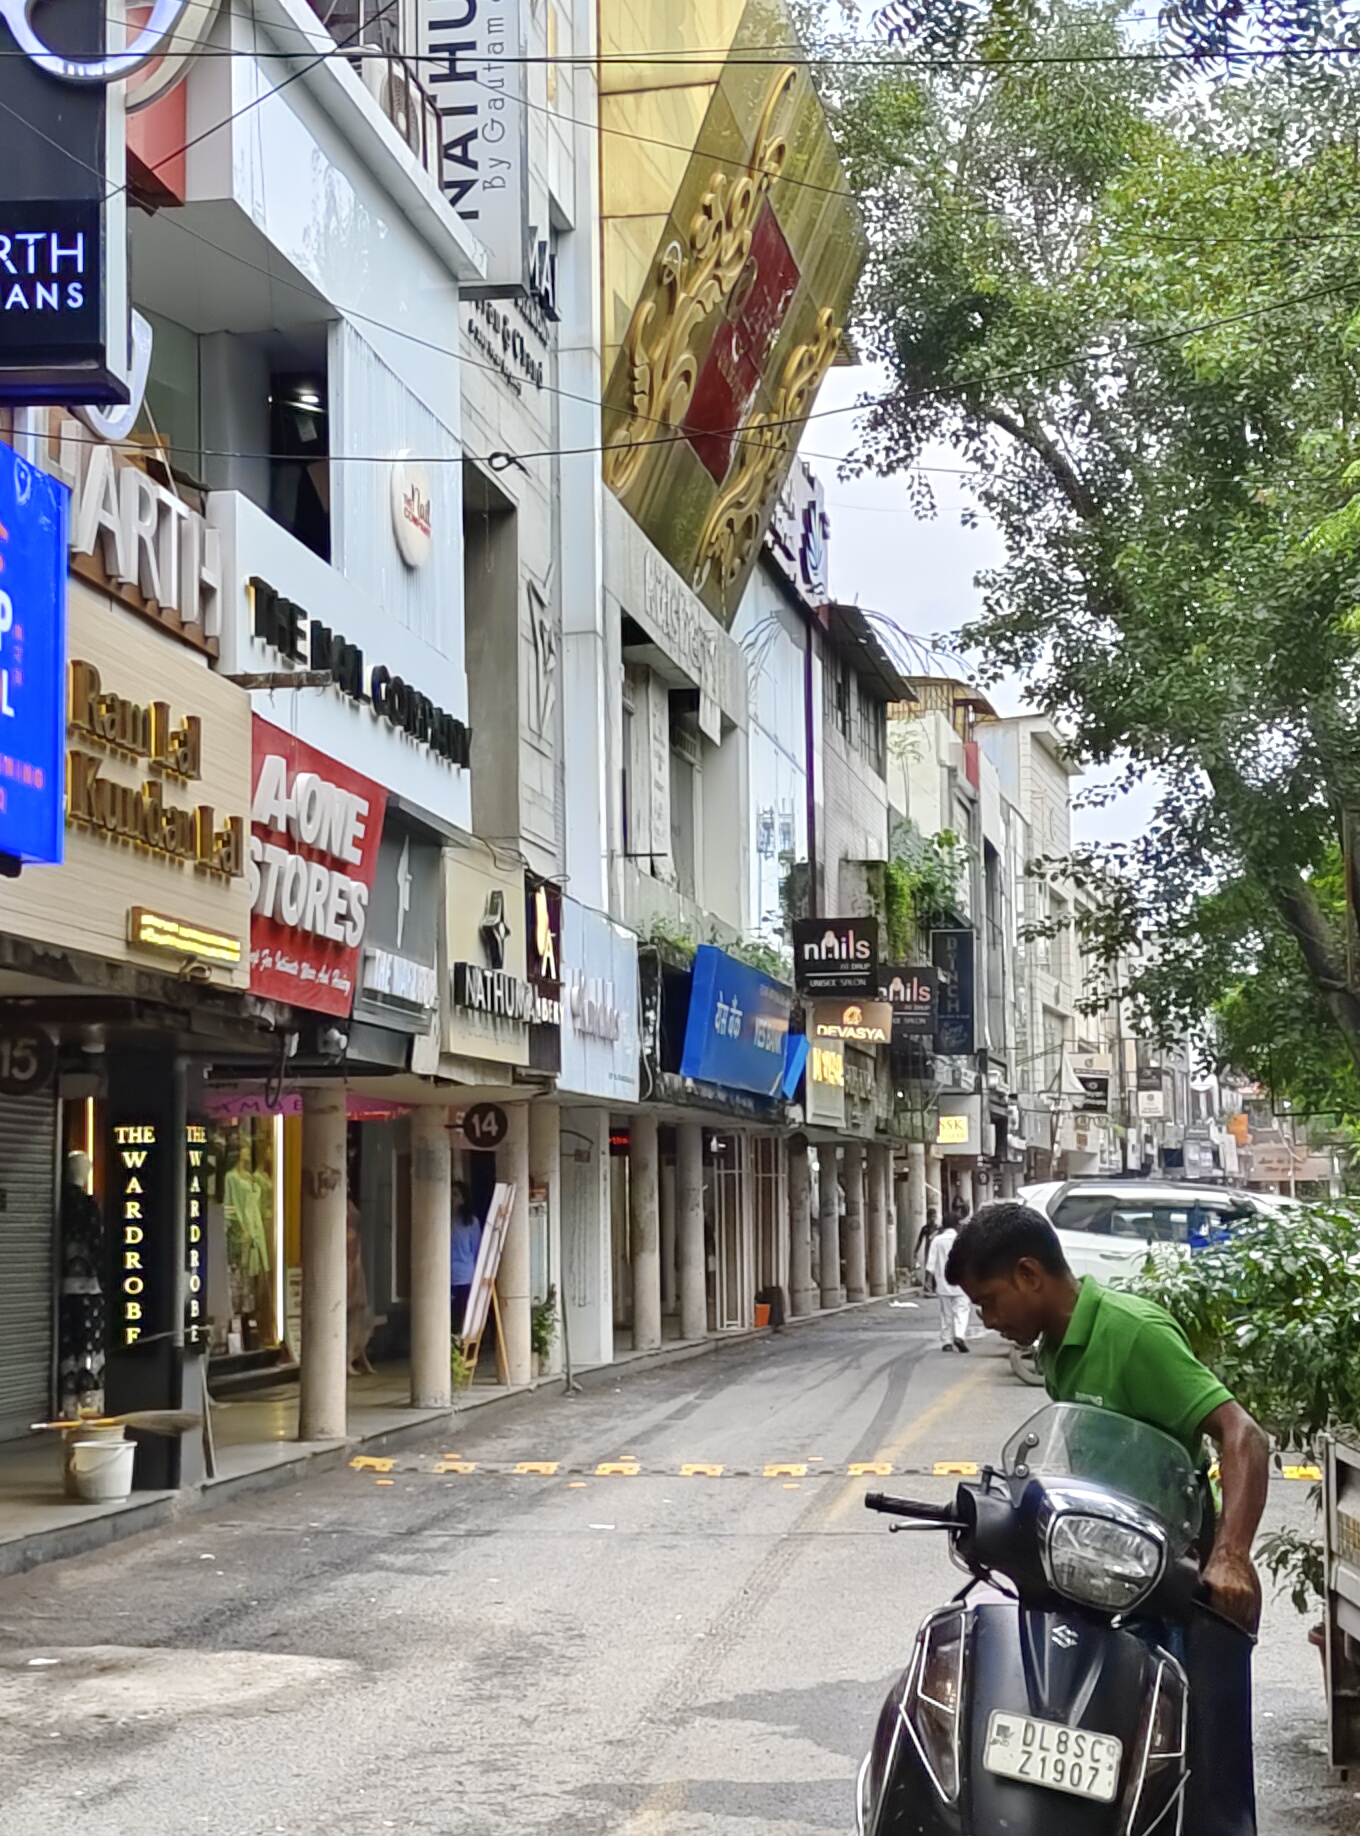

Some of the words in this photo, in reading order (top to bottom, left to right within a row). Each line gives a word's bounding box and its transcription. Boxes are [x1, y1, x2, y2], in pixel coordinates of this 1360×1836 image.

[482, 15, 506, 150] Gautam
[482, 167, 508, 192] By
[252, 754, 369, 866] A-ONE
[250, 836, 369, 948] STORES
[817, 1024, 886, 1041] DEVASYA
[0, 1037, 37, 1081] 15
[114, 1126, 156, 1144] THE
[186, 1126, 207, 1143] THE
[471, 1111, 499, 1139] 14
[189, 1151, 203, 1343] WARDROBE
[1023, 1722, 1104, 1763] DL8SC
[1018, 1750, 1099, 1790] Z1907
